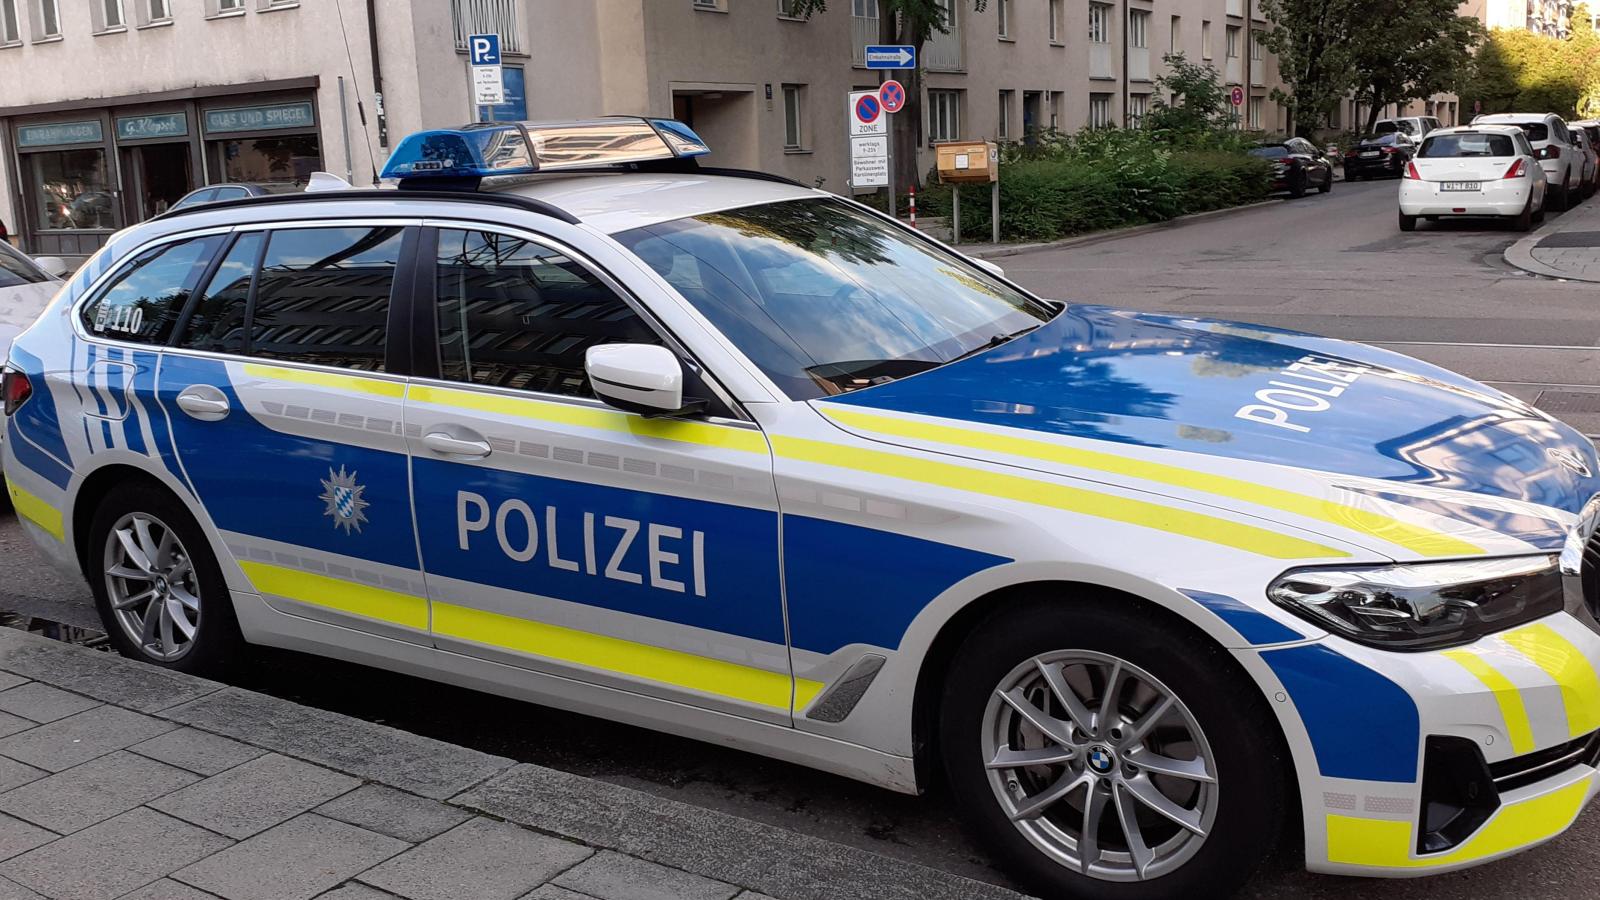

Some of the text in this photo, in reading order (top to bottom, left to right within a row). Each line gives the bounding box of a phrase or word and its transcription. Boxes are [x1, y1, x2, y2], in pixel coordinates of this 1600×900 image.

[474, 38, 490, 62] P
[210, 108, 307, 127] GLAS UND SPIEGEL
[859, 125, 879, 133] ZONE
[111, 305, 143, 334] 110
[457, 490, 706, 597] POLIZEI
